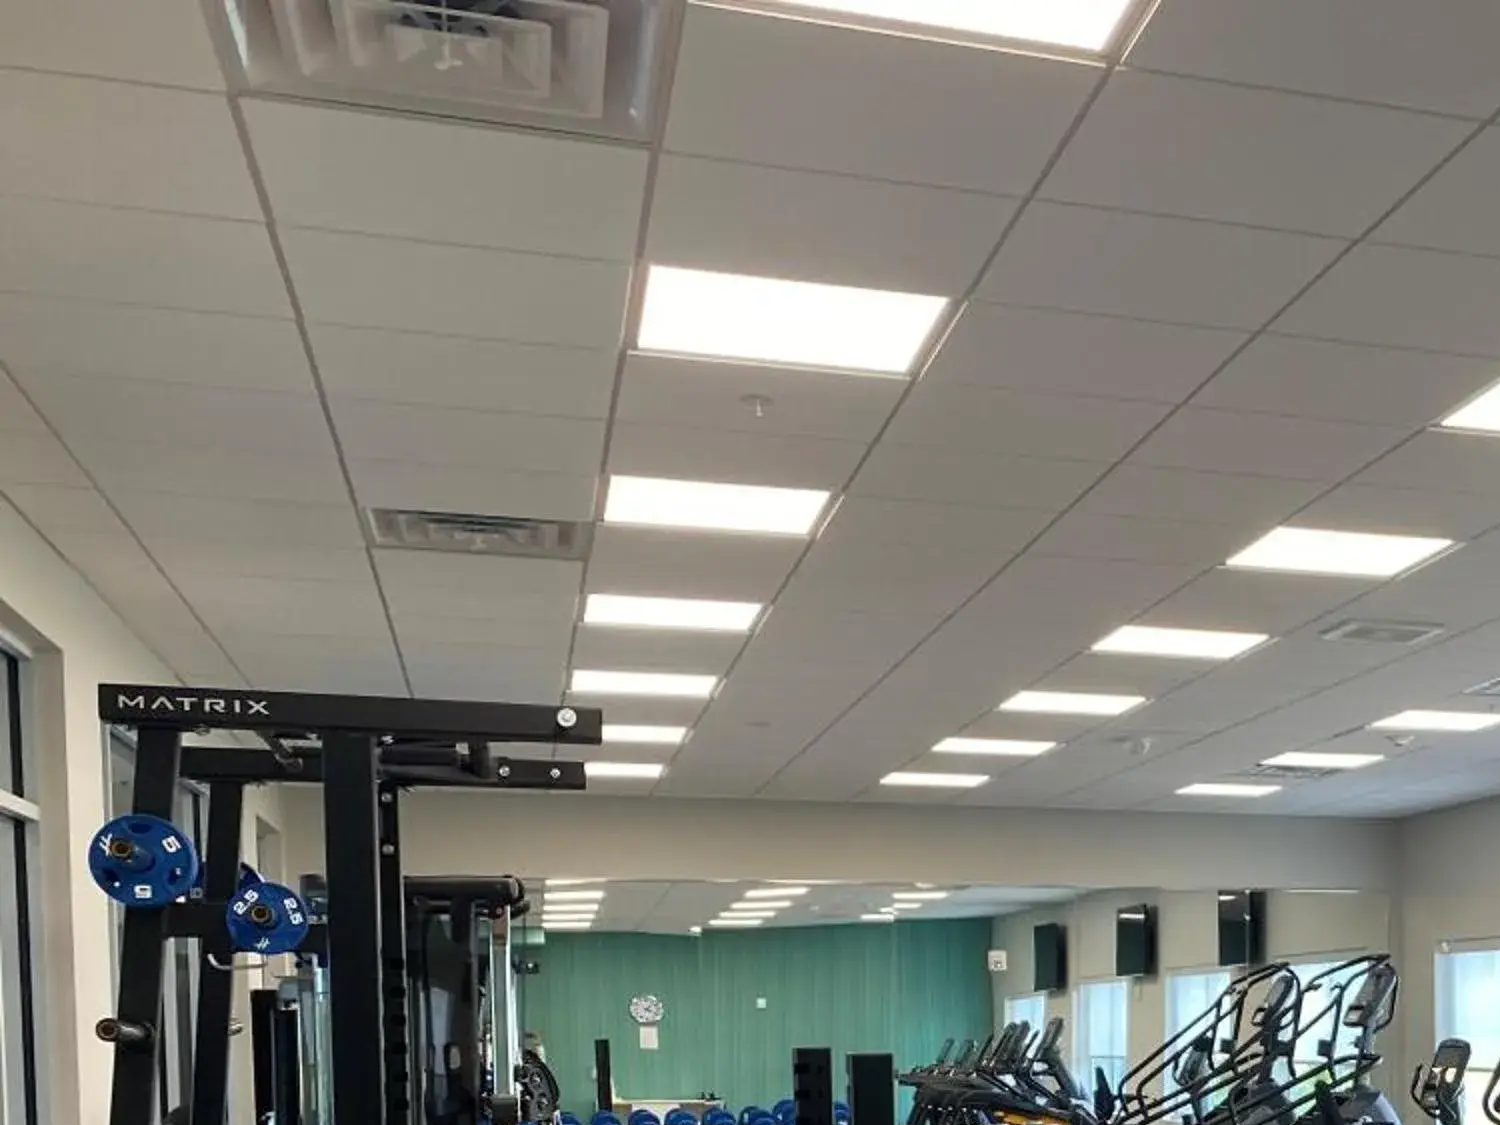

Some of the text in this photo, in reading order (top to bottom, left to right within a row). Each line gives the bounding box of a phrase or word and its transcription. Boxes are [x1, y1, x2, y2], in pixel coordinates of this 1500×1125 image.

[117, 694, 270, 715] MATRIX
[233, 889, 259, 915] 2.5
[283, 897, 303, 925] 2.5
